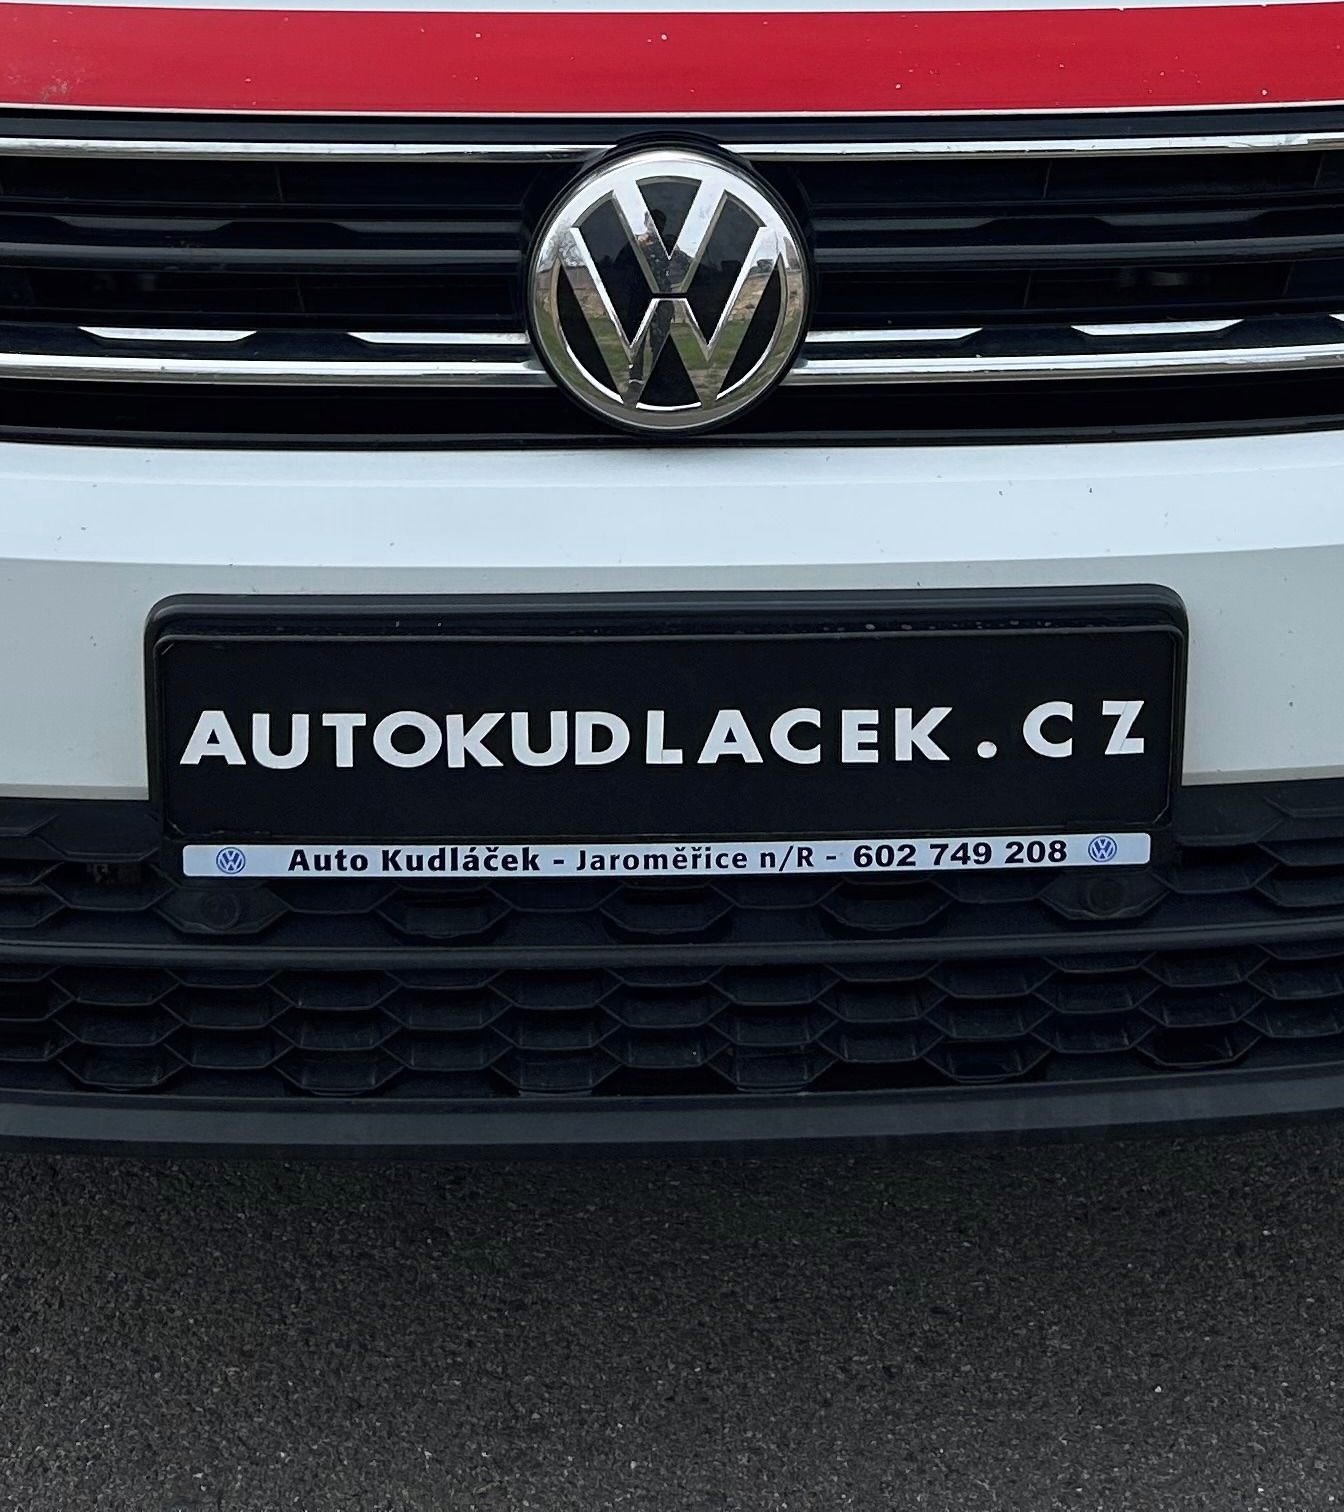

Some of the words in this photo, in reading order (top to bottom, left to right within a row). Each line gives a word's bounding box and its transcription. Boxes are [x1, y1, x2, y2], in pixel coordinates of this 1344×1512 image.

[288, 848, 369, 873] Auto
[381, 846, 541, 873] Kudláček
[575, 845, 748, 873] Jaroměřice
[760, 844, 814, 873] n/R
[852, 843, 917, 869] 602
[929, 841, 993, 866] 749
[1004, 839, 1068, 865] 208
